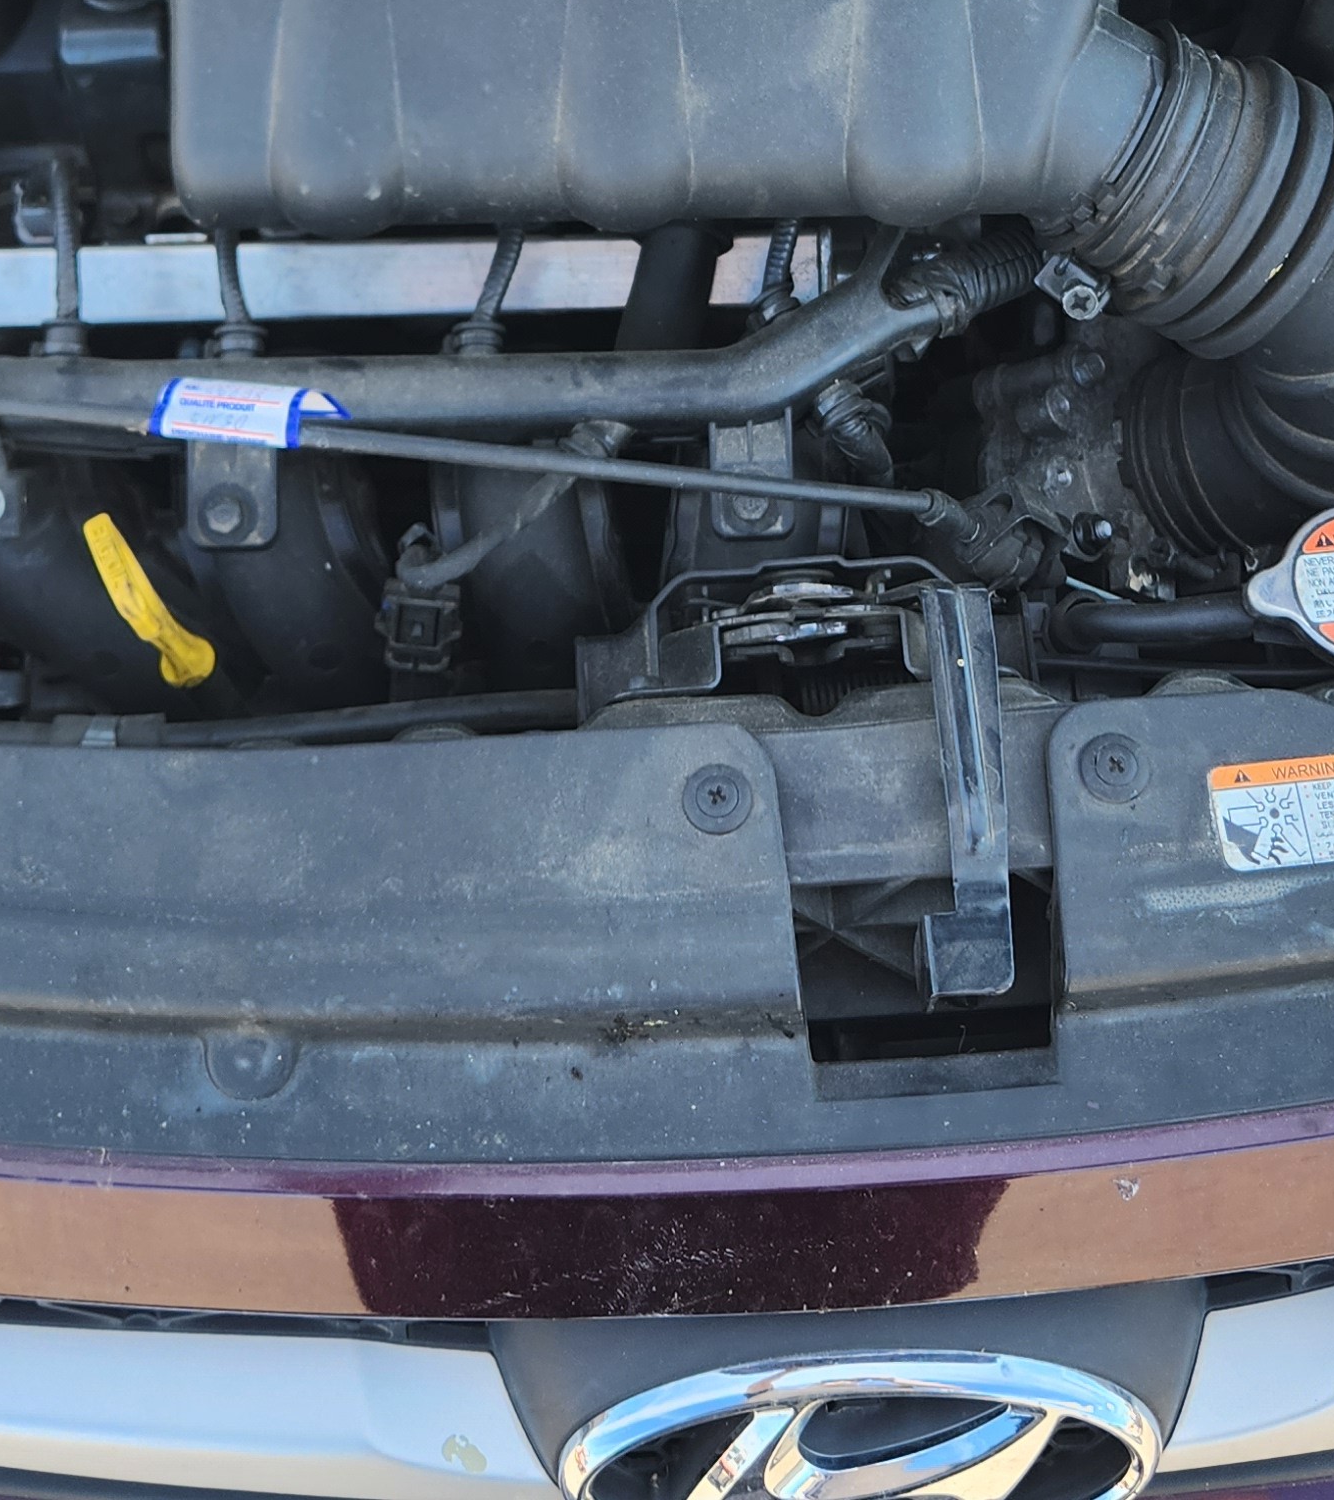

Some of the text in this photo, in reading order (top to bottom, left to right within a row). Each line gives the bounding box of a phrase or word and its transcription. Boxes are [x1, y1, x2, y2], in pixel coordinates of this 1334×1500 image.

[217, 402, 257, 412] PRODUIT
[1303, 556, 1334, 567] NEVER
[1306, 568, 1318, 577] NE
[1309, 578, 1326, 588] NON
[1313, 782, 1332, 791] KEEP
[1317, 800, 1334, 811] LES
